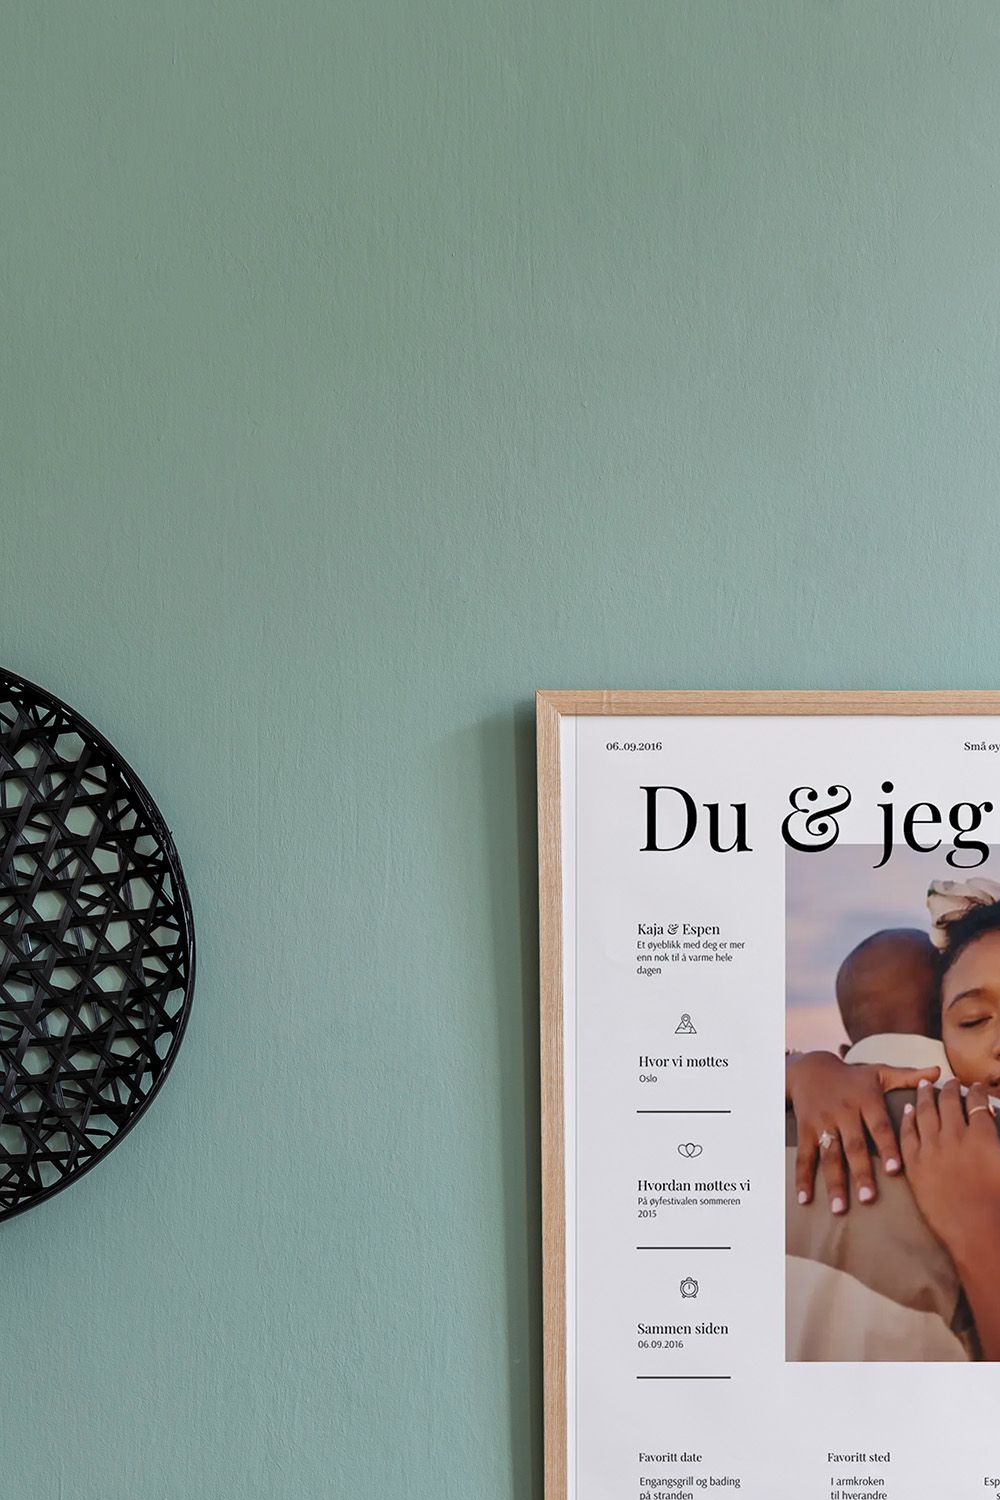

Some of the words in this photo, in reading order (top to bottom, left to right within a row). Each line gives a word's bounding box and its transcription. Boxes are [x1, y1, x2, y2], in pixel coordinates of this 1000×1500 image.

[963, 741, 986, 752] Små
[639, 786, 753, 853] Du
[781, 784, 852, 853] &
[873, 781, 994, 869] jeg
[637, 922, 664, 937] Kaja
[667, 923, 680, 936] &
[682, 923, 720, 937] Espen
[637, 940, 646, 949] Et
[647, 940, 681, 951] øyeblikk
[683, 940, 700, 949] med
[702, 940, 718, 951] deg
[654, 953, 669, 962] nok
[671, 953, 680, 962] til
[681, 953, 687, 962] å
[715, 953, 733, 962] hele
[636, 965, 662, 977] dagen
[638, 1055, 670, 1067] Hvor
[671, 1055, 683, 1067] vi
[686, 1055, 729, 1068] møttes
[638, 1074, 658, 1083] Oslo
[637, 1179, 691, 1192] Hvordan
[694, 1180, 737, 1192] møttes
[739, 1179, 751, 1192] vi
[637, 1196, 649, 1205] På
[649, 1196, 698, 1207] øyfestivalen
[637, 1209, 657, 1218] 2015
[637, 1323, 692, 1335] Sammen
[695, 1322, 729, 1335] siden
[637, 1340, 684, 1349] 06.09.2016
[638, 1452, 677, 1462] Favoritt
[680, 1452, 703, 1462] date
[827, 1452, 866, 1462] Favoritt
[868, 1452, 891, 1462] sted
[639, 1476, 694, 1488] Engangsgrill
[695, 1478, 708, 1488] og
[709, 1476, 741, 1488] bading
[830, 1476, 834, 1486] I
[835, 1476, 885, 1486] armkroken
[653, 1490, 694, 1500] stranden
[830, 1490, 840, 1500] til
[841, 1490, 888, 1500] hverandre
